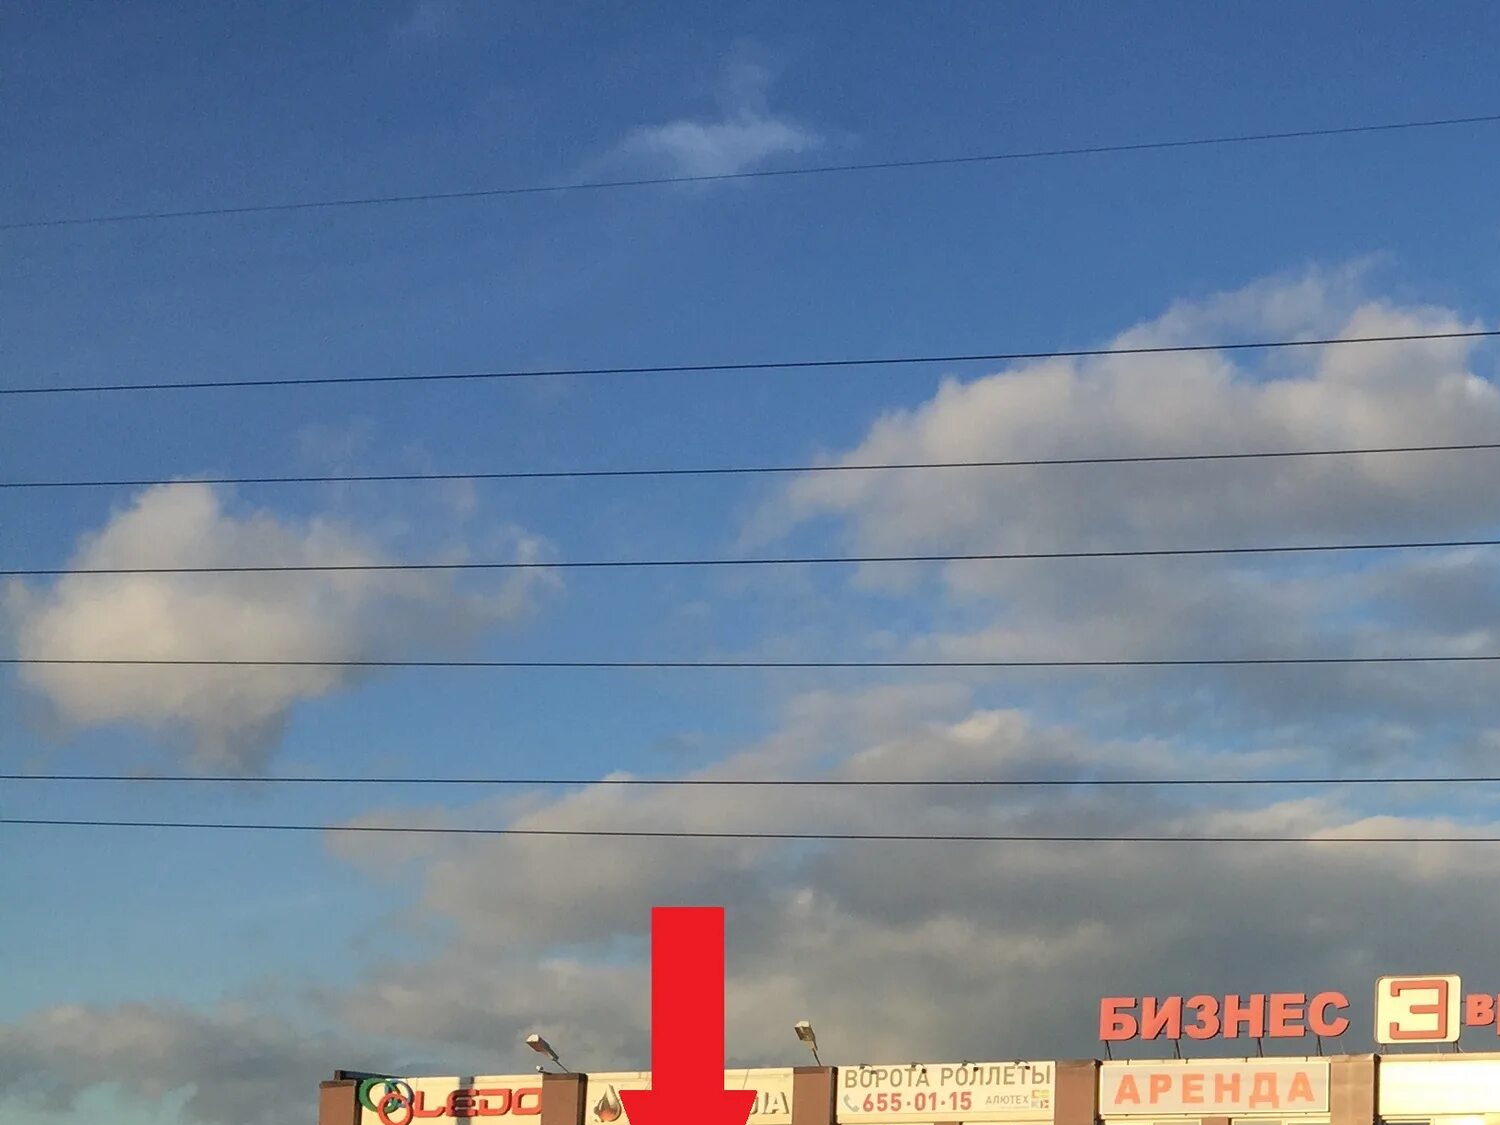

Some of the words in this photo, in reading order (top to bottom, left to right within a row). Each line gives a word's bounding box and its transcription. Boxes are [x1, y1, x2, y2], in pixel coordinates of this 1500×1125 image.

[1099, 991, 1351, 1041] БИЗНЕС
[844, 1068, 930, 1089] ВОРОТА
[940, 1065, 1051, 1087] РОЛЛЕТЫ
[1114, 1071, 1316, 1109] АРЕНДА
[985, 1095, 1029, 1105] АЛЮТЕХ
